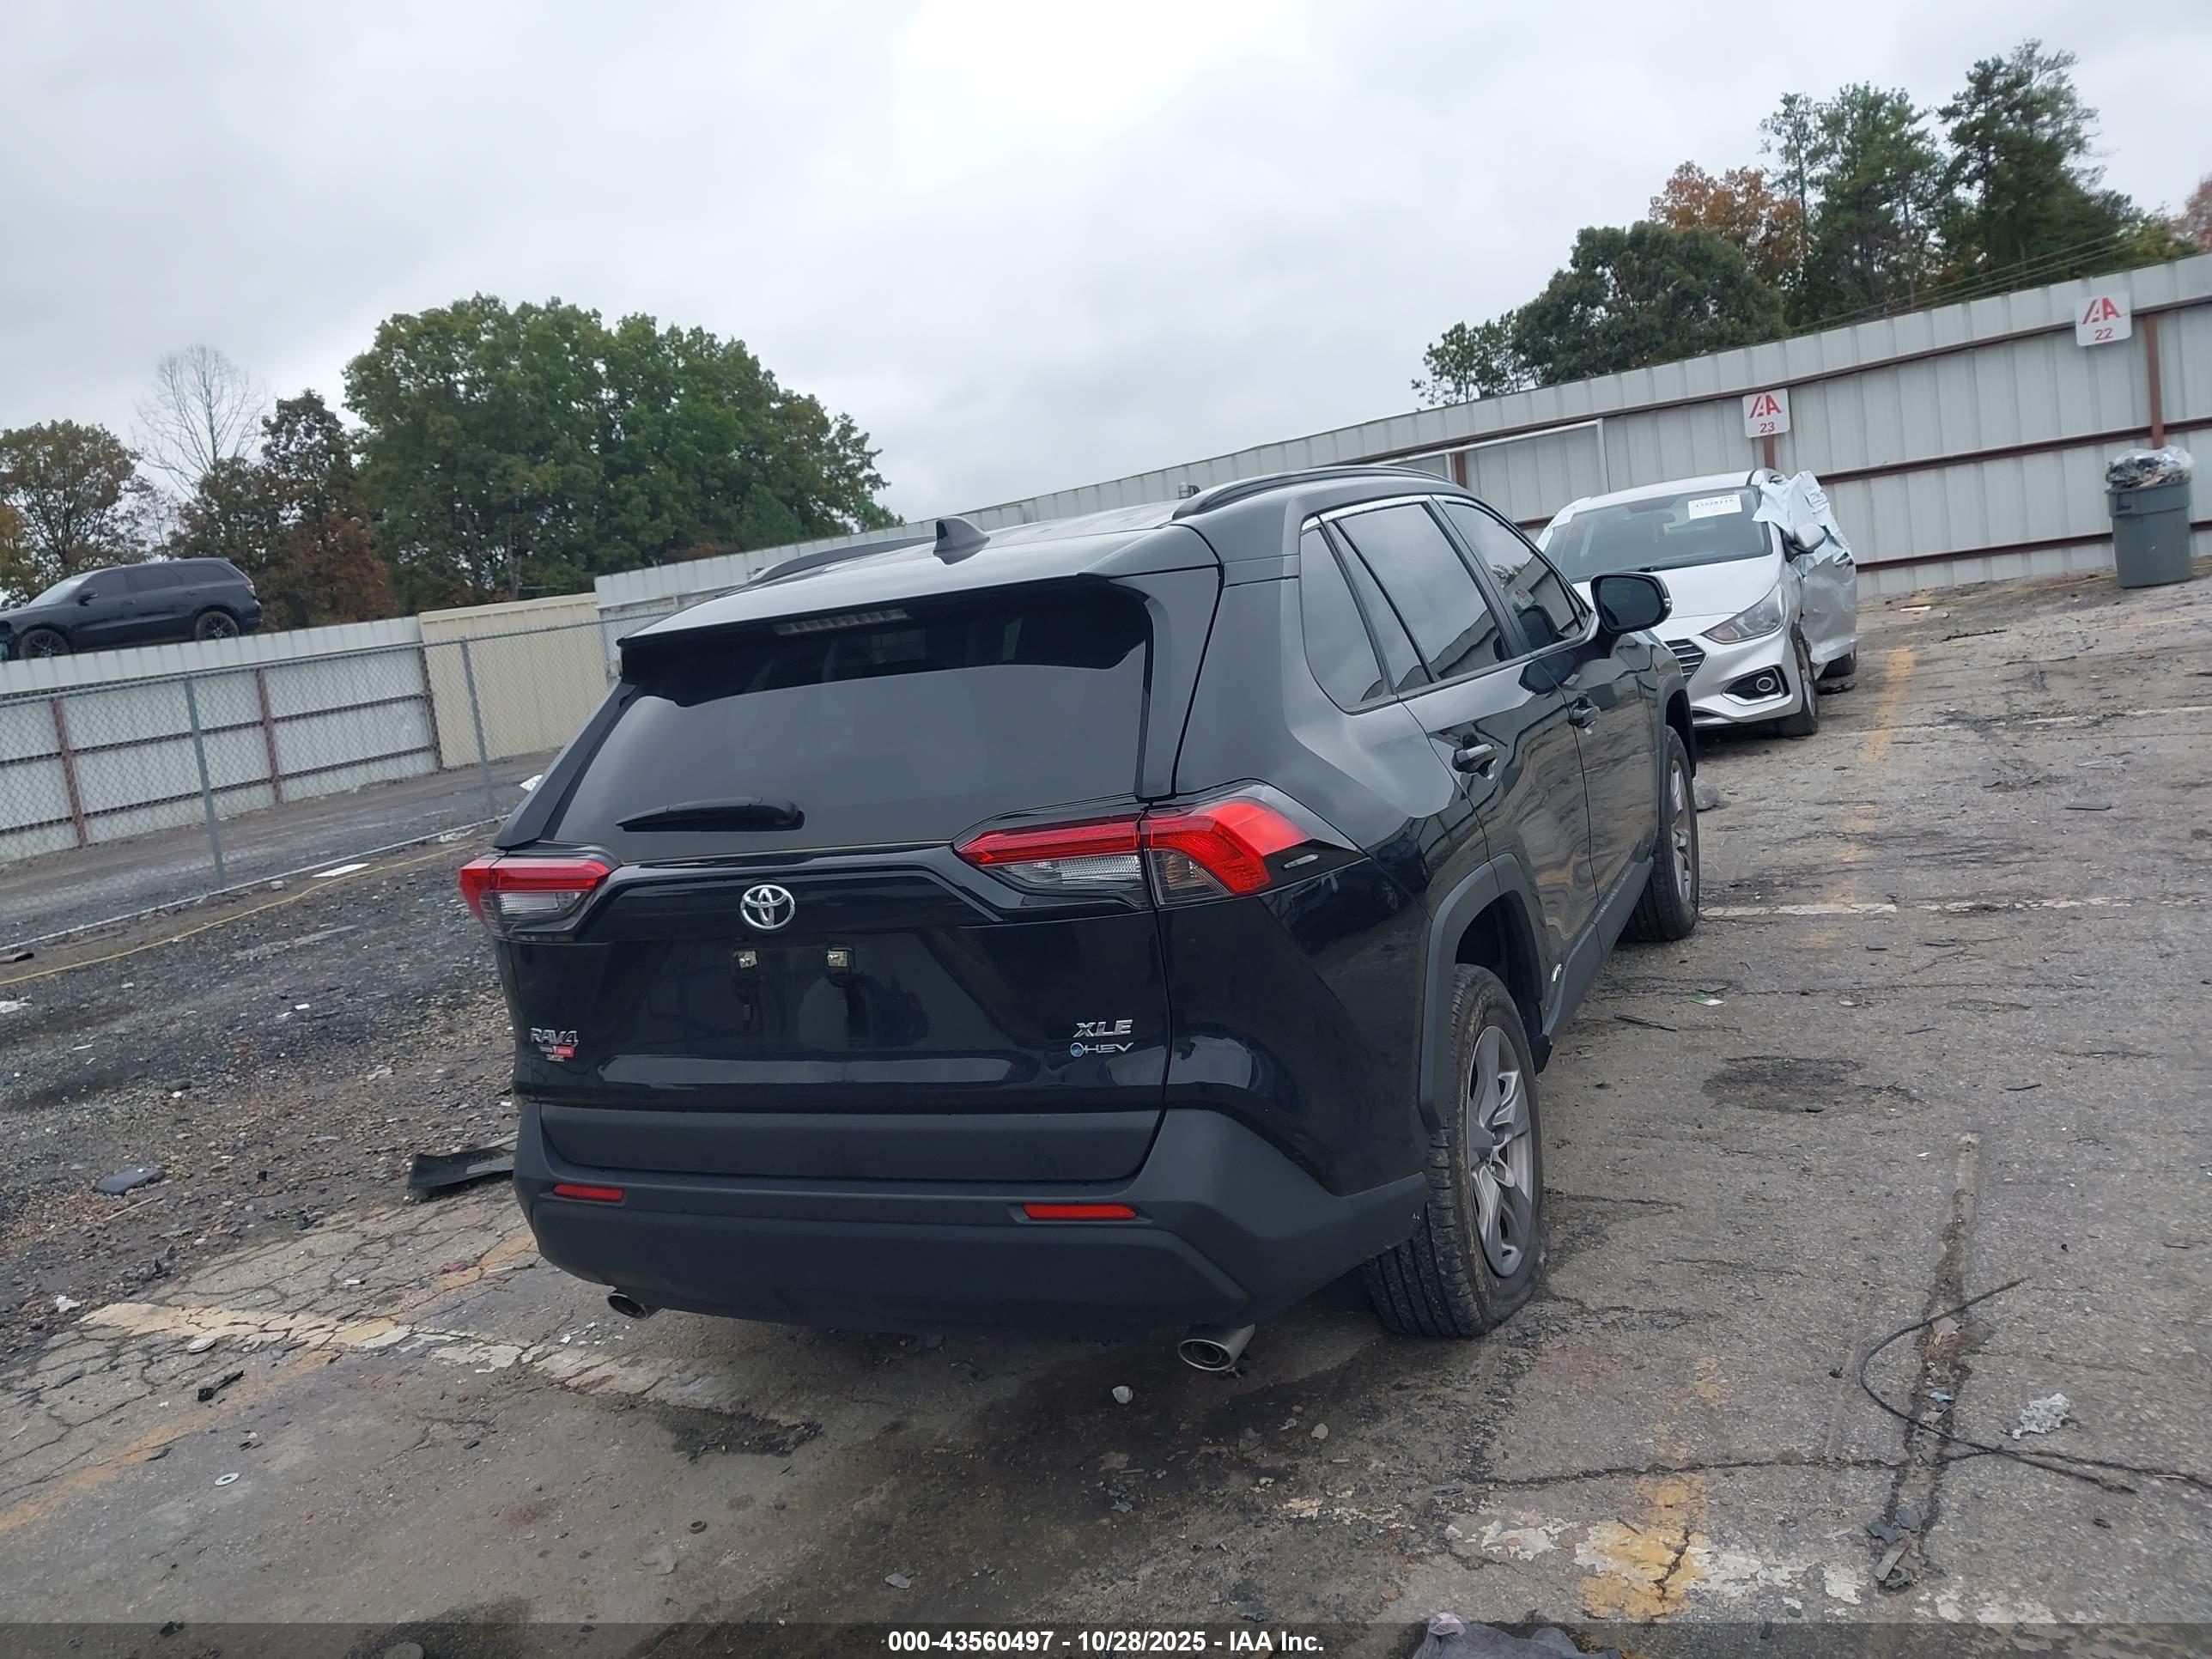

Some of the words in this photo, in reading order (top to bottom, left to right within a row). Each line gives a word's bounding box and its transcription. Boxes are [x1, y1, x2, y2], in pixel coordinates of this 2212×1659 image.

[2094, 327, 2113, 341] 22
[1759, 422, 1775, 434] 23
[1073, 1019, 1133, 1038] XLE
[530, 1027, 579, 1047] RAV4
